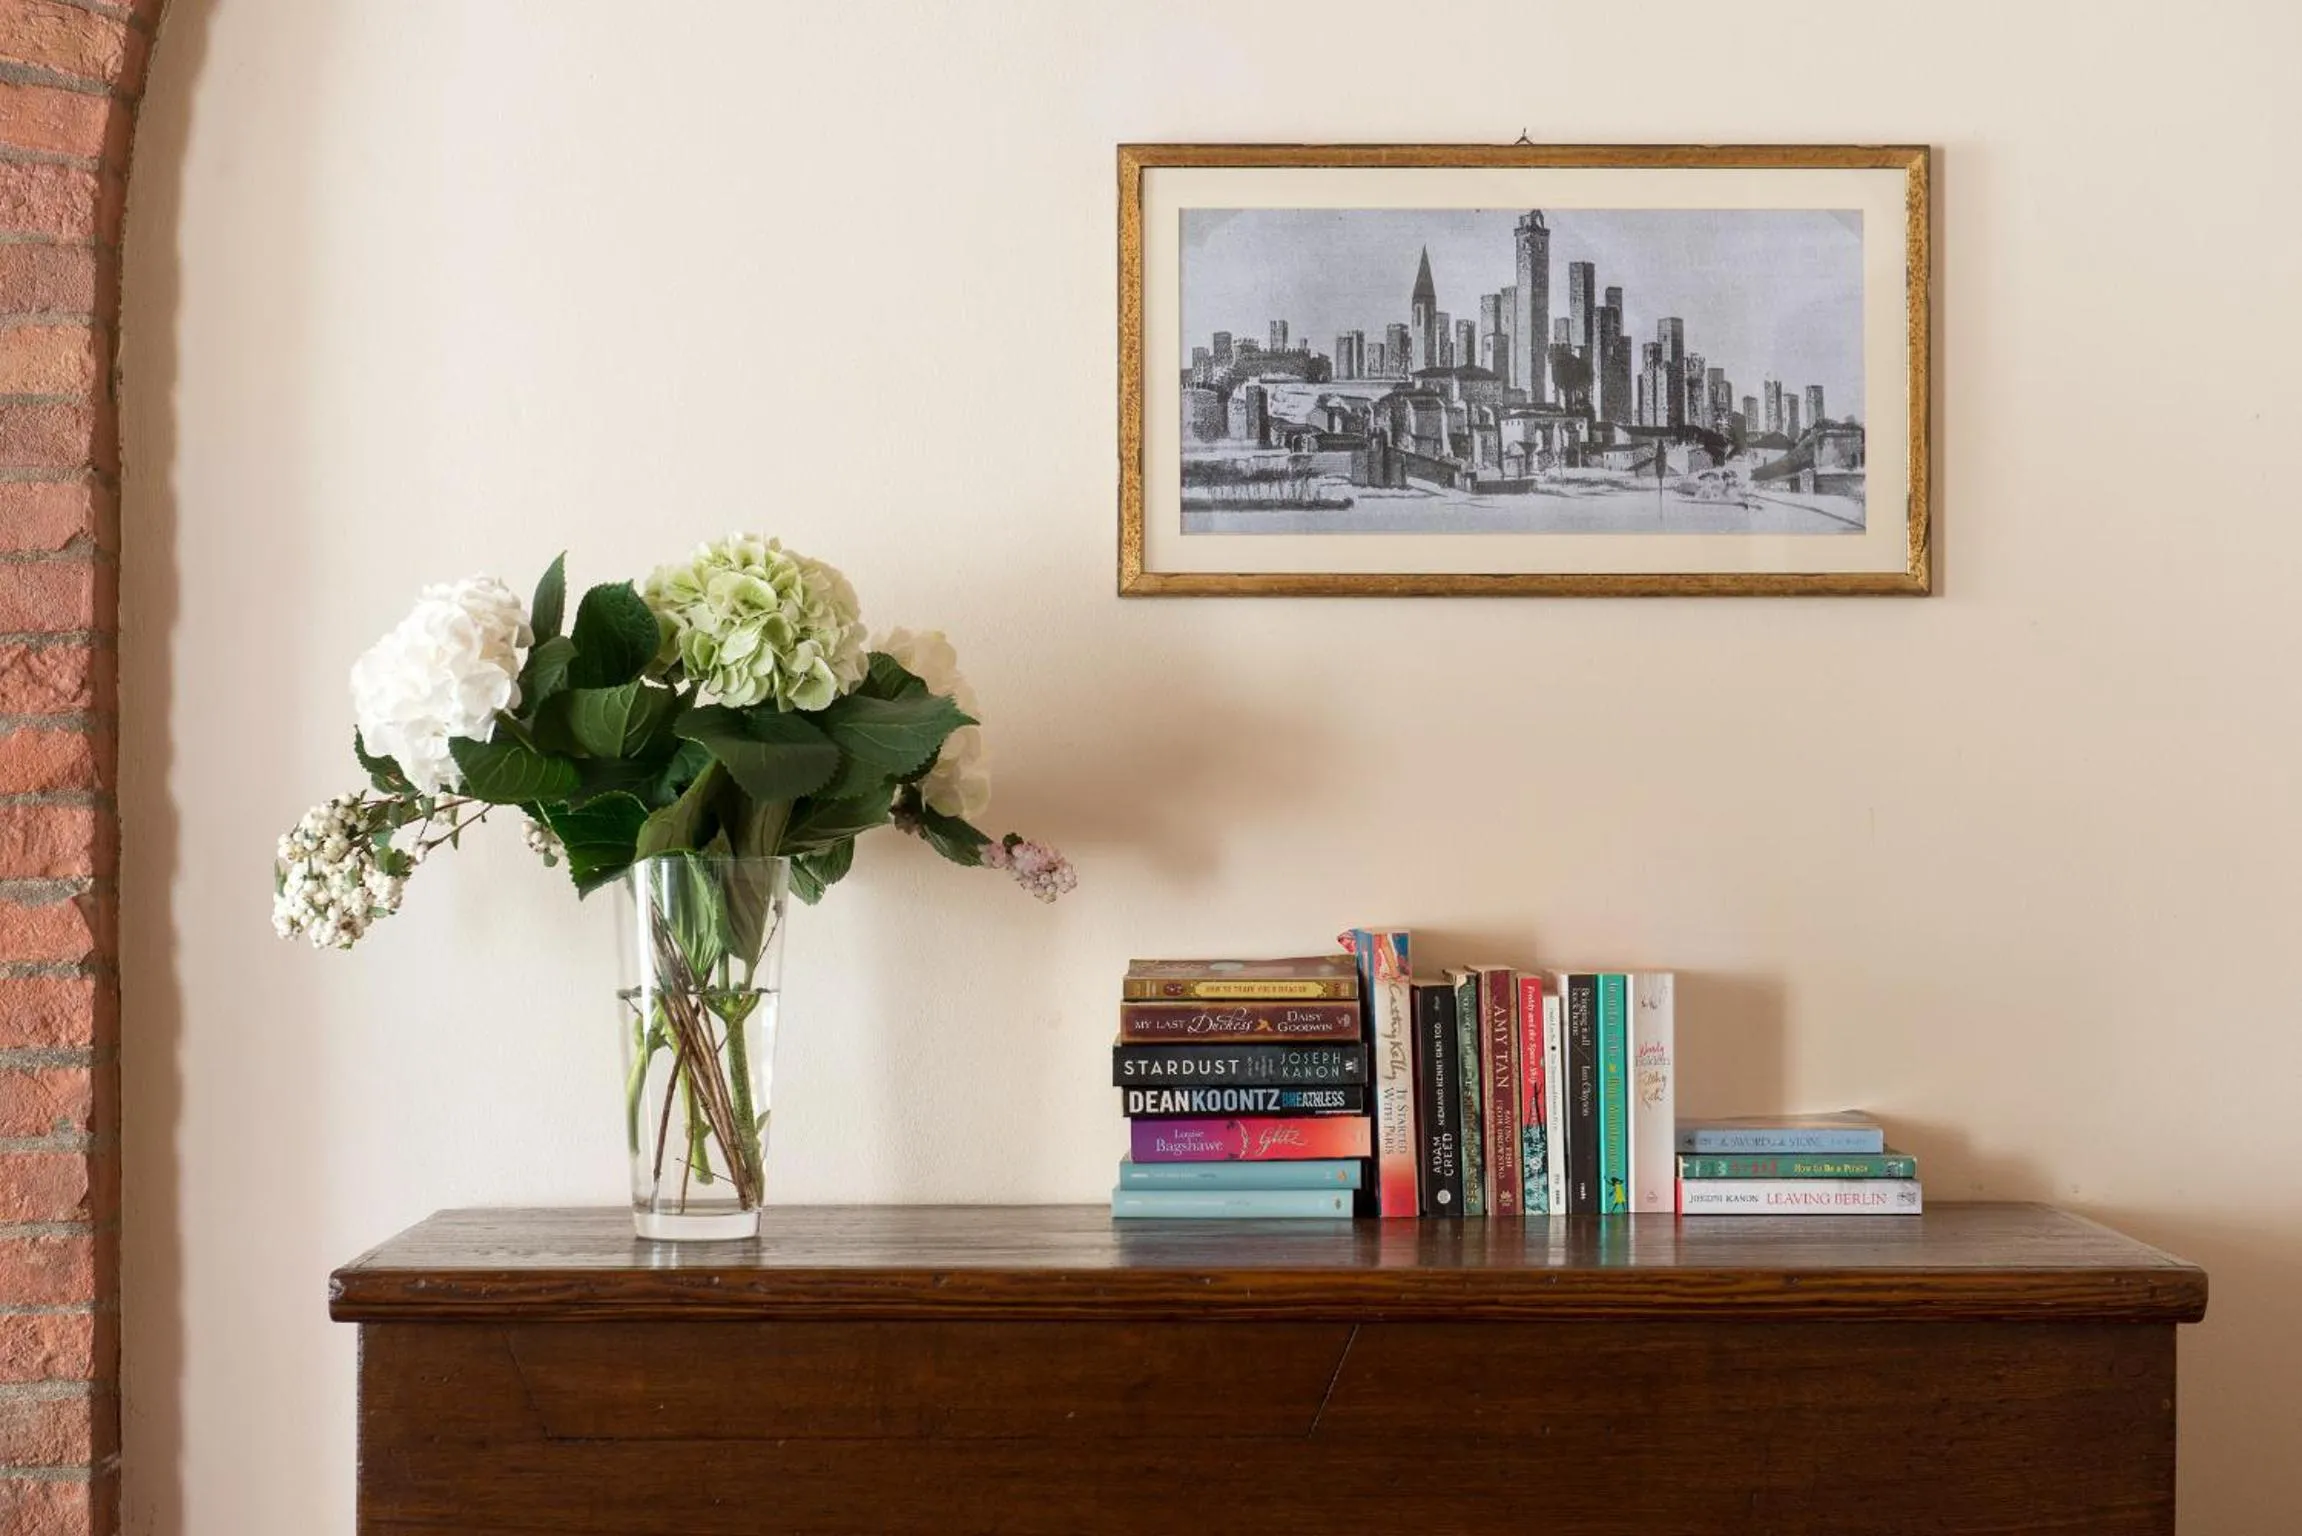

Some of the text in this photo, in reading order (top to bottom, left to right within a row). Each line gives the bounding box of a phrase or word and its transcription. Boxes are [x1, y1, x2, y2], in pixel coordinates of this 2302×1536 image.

[1525, 985, 1537, 1011] Freddy
[1135, 1020, 1152, 1030] MY
[1156, 1019, 1186, 1029] LAST
[1277, 1021, 1333, 1032] GOODWIN
[1528, 1012, 1536, 1027] and
[1528, 1029, 1537, 1041] the
[1581, 1034, 1591, 1045] all
[1493, 1005, 1509, 1088] AMY TAN
[1526, 1043, 1538, 1065] Space
[1280, 1051, 1341, 1065] JOSEPH
[1123, 1059, 1240, 1075] STARDUST
[1282, 1065, 1340, 1078] KANON
[1582, 1065, 1591, 1080] Ian
[1128, 1089, 1189, 1113] DEAN
[1191, 1088, 1281, 1112] KOONTZ
[1156, 1138, 1224, 1156] Bagshawe
[1432, 1136, 1443, 1174] ADAM
[1442, 1133, 1454, 1177] CREED
[1793, 1163, 1811, 1173] How
[1813, 1164, 1823, 1172] to
[1726, 1194, 1759, 1203] KANON
[1767, 1193, 1888, 1205] LEAVING BERLIN
